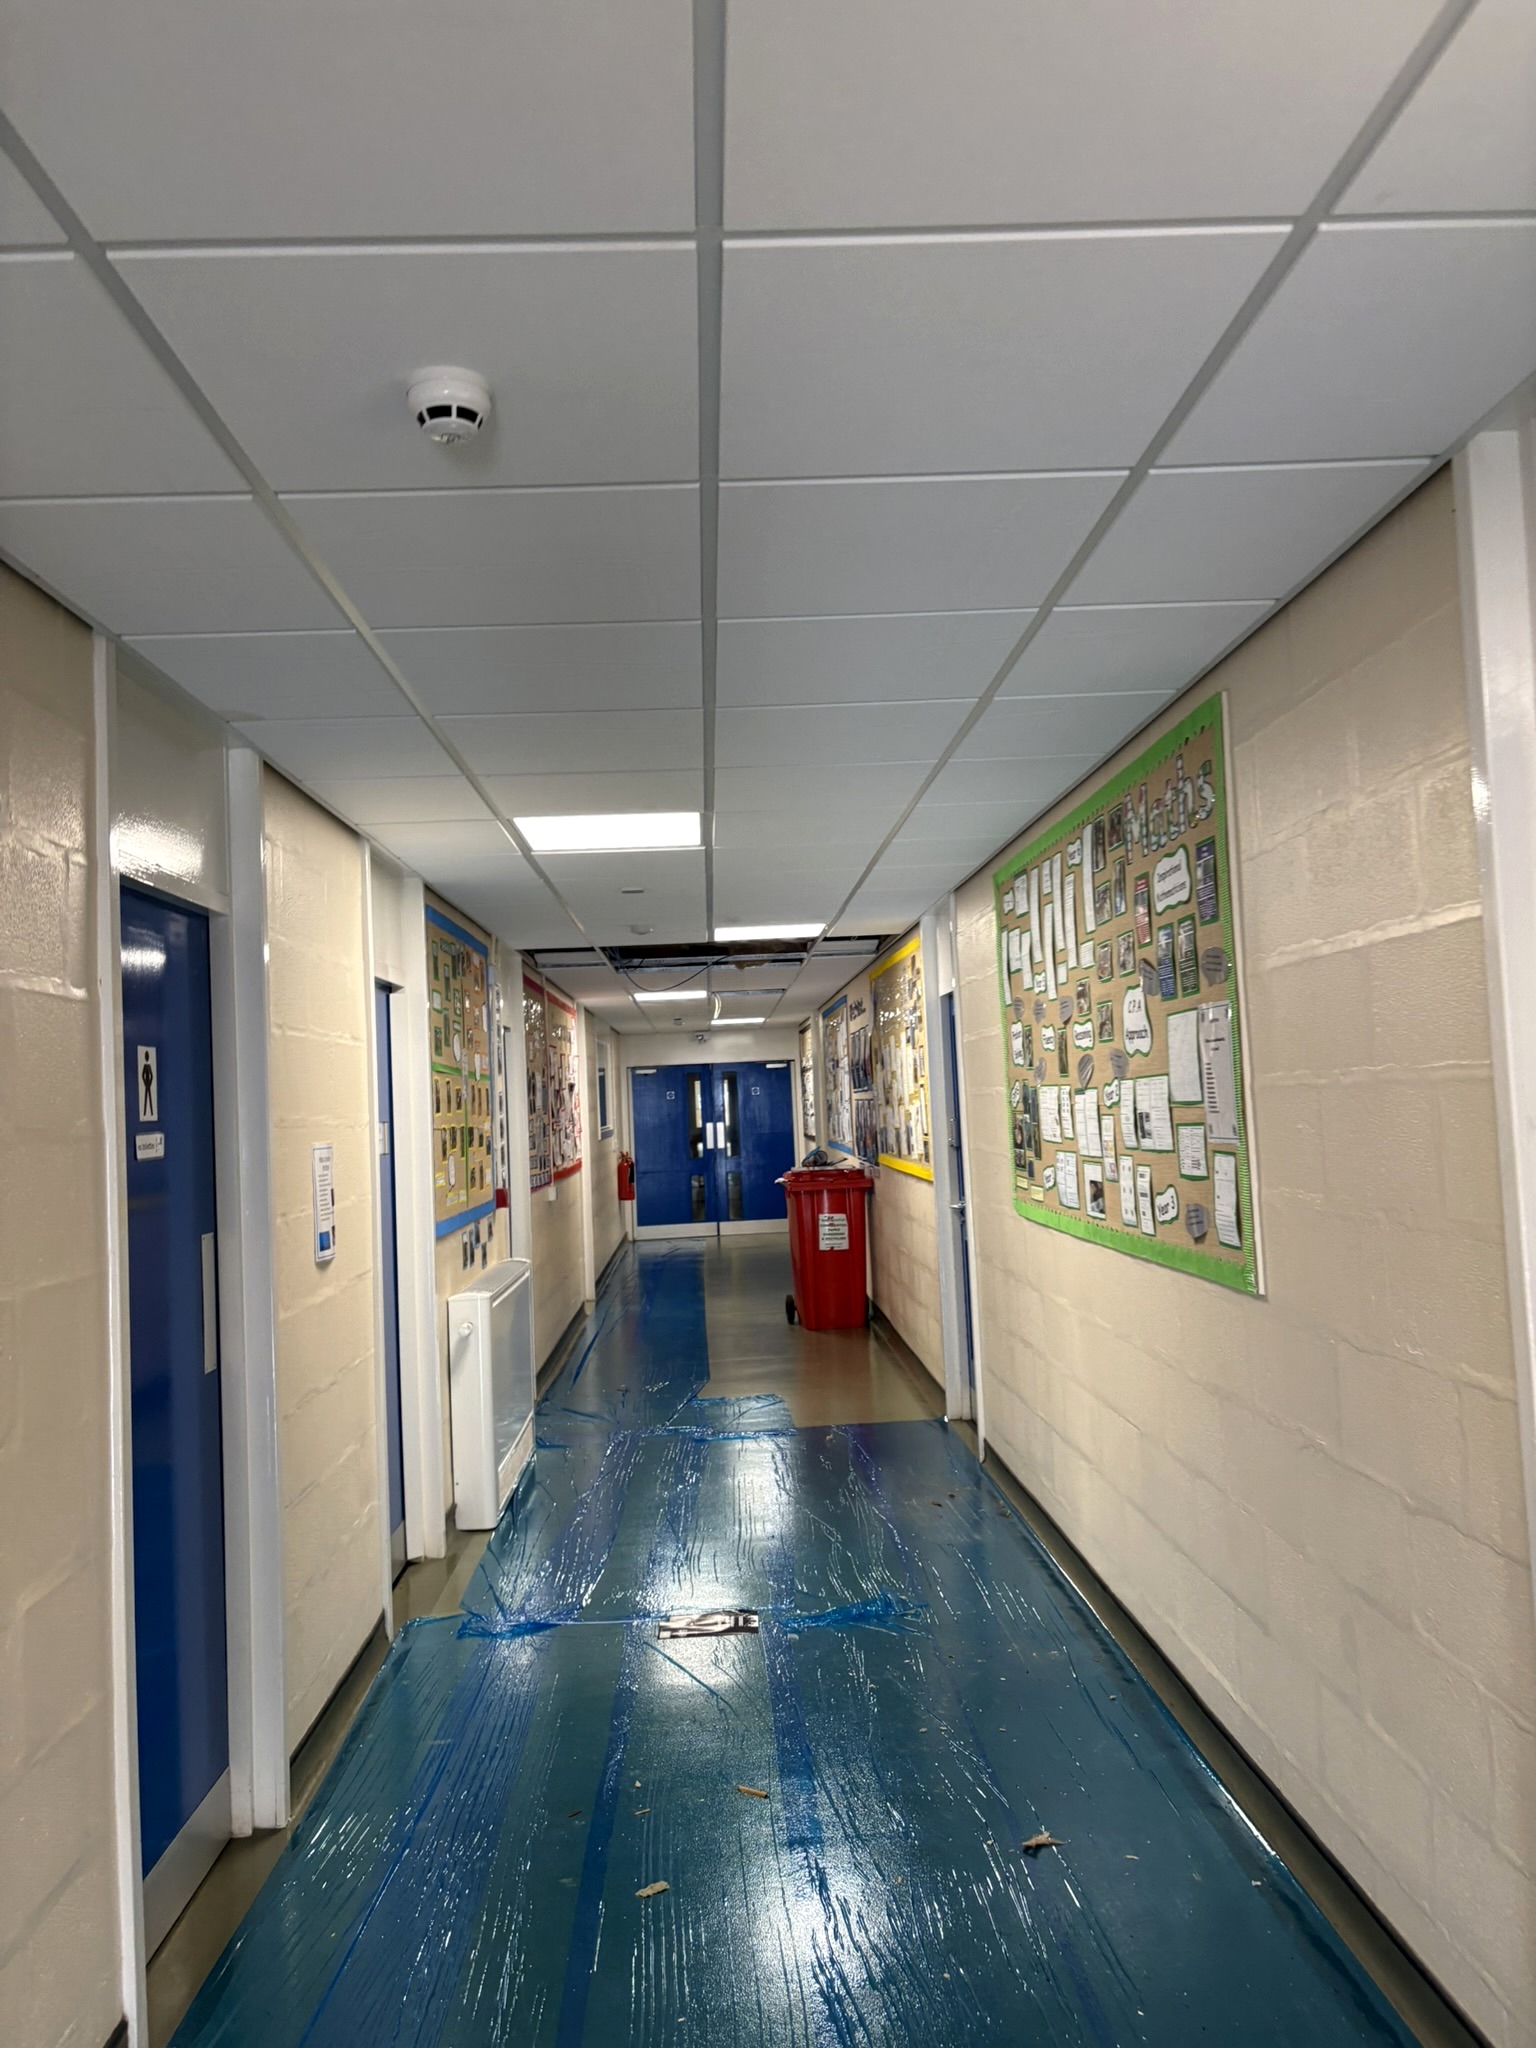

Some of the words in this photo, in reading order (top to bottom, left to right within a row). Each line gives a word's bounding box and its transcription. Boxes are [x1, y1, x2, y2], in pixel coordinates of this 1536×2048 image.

[1123, 753, 1215, 866] Maths
[1156, 859, 1182, 884] Inspirational
[1125, 1024, 1149, 1045] Approach
[1156, 1202, 1171, 1218] Year
[1170, 1194, 1176, 1210] 3
